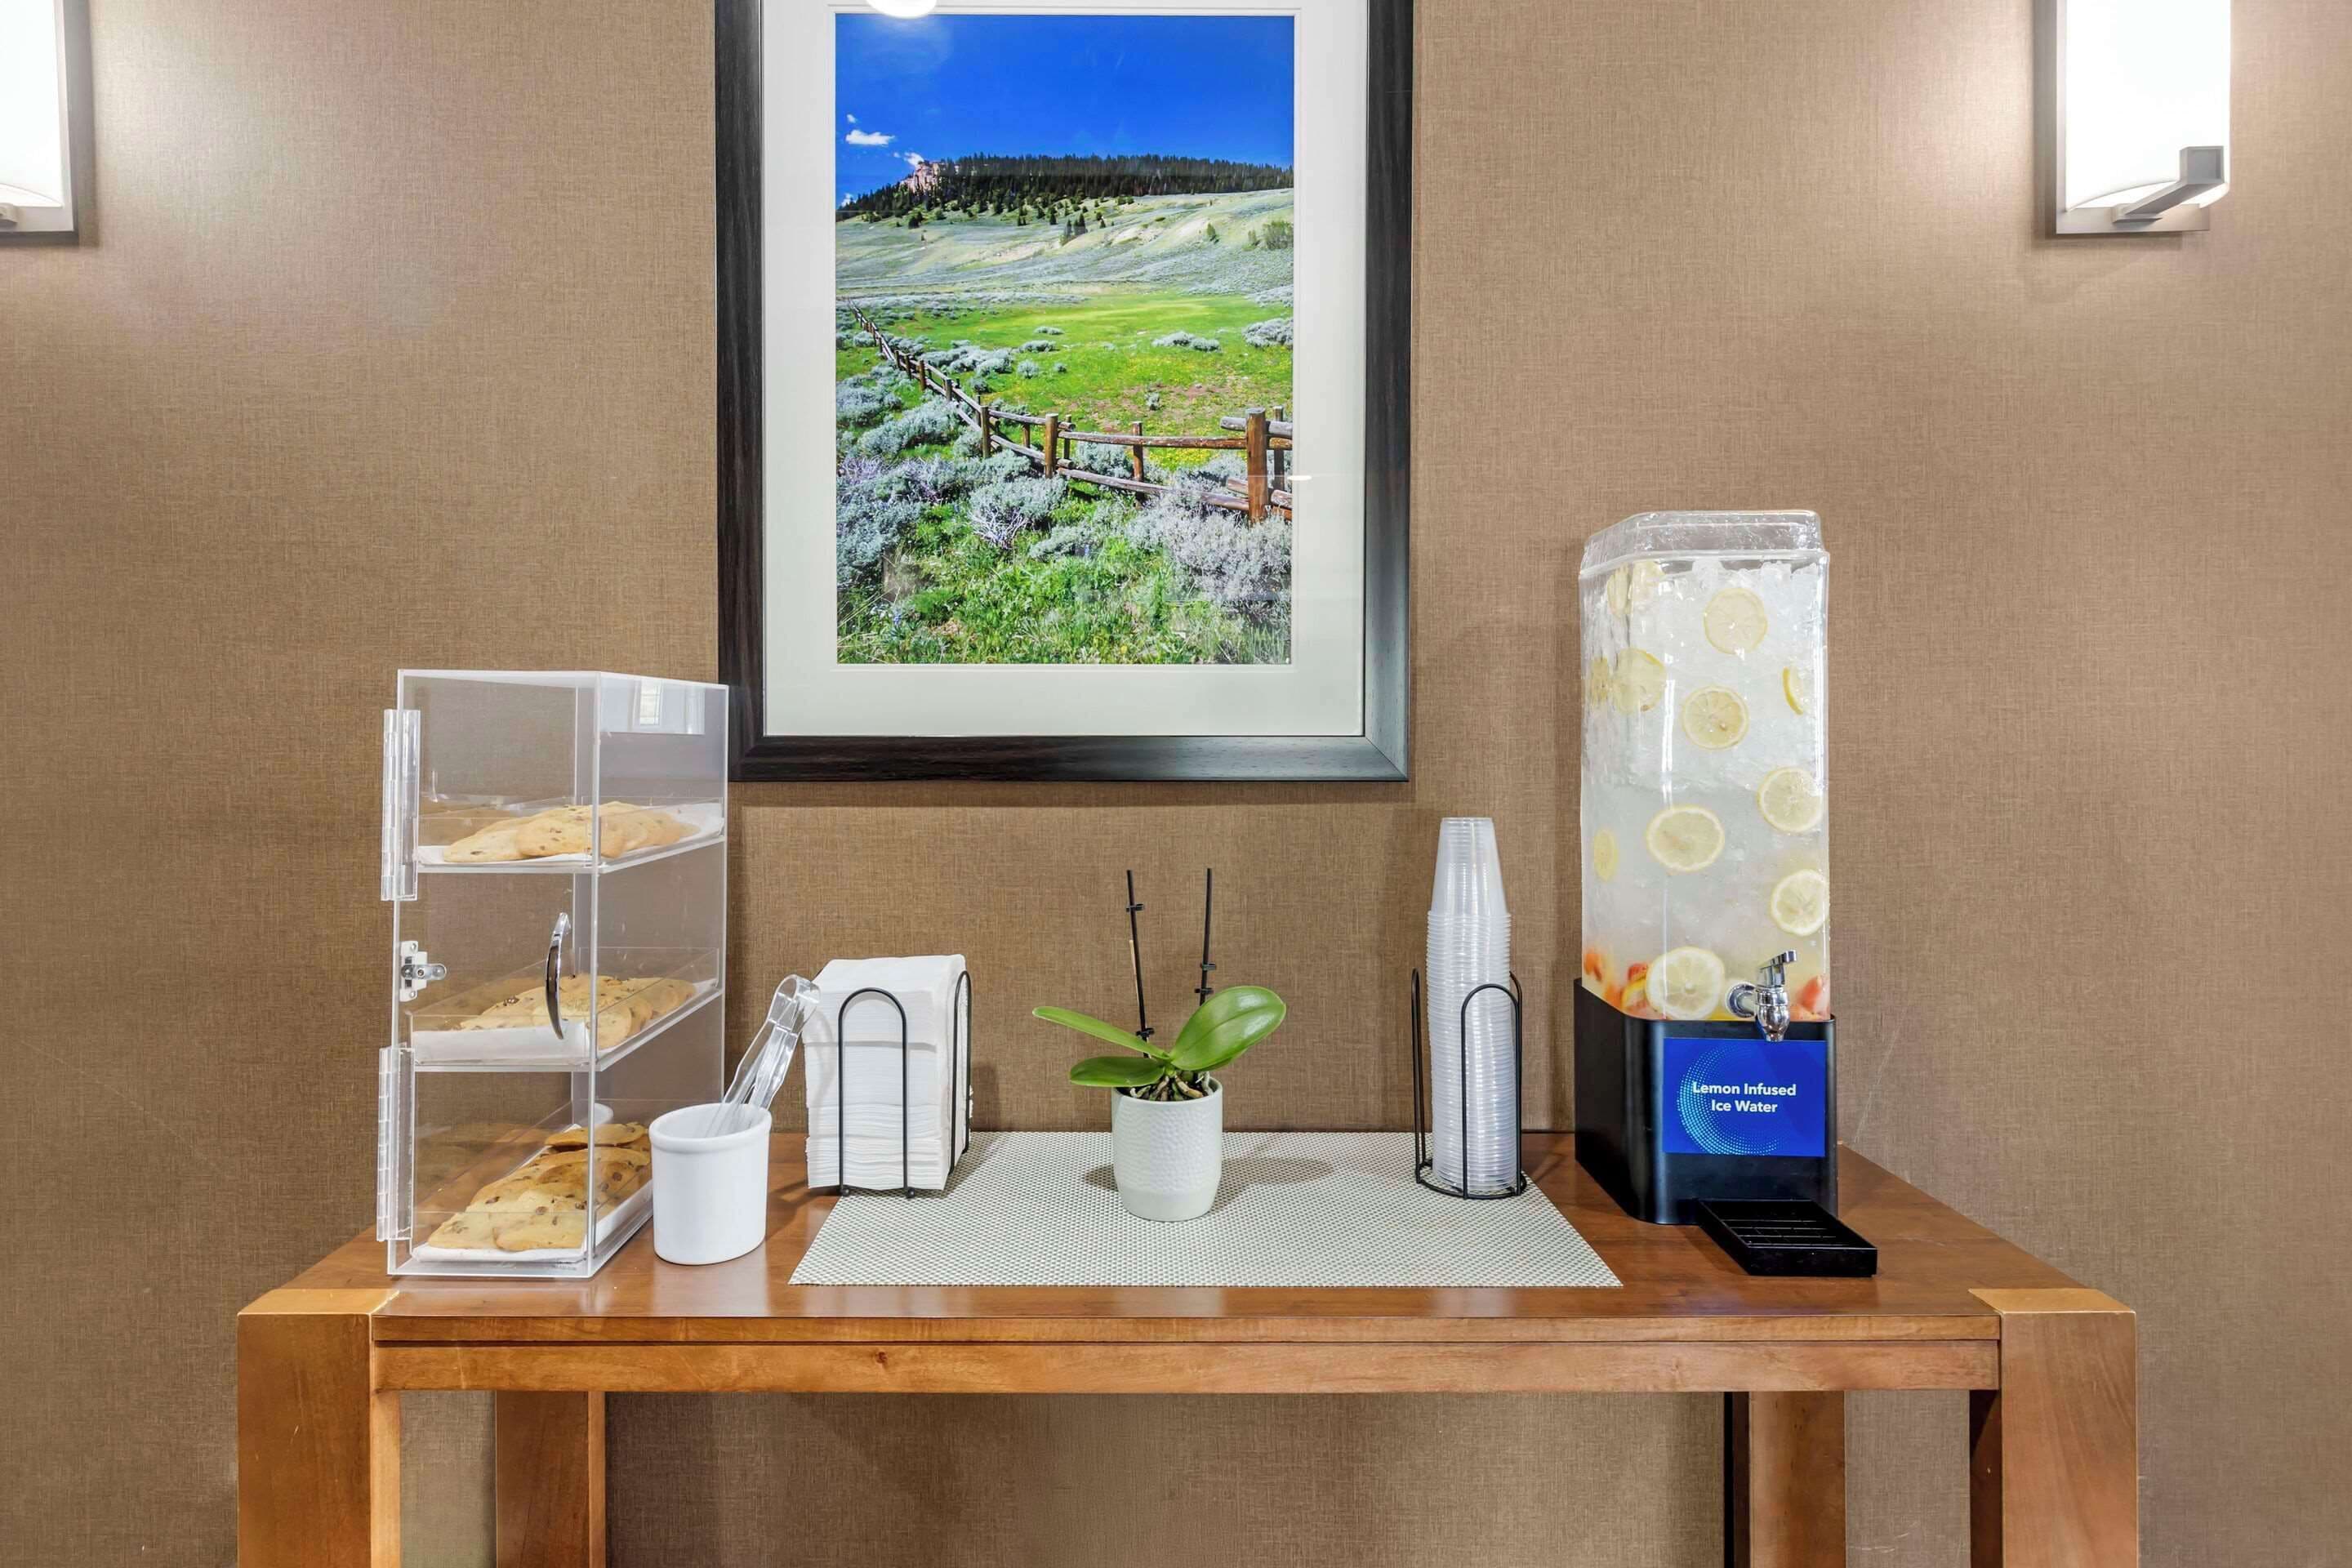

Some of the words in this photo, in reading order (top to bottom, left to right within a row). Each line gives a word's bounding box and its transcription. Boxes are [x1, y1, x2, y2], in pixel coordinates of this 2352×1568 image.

[1692, 1081, 1740, 1094] Lemon
[1744, 1083, 1797, 1096] Infused
[1711, 1099, 1731, 1111] Ice
[1735, 1100, 1778, 1112] Water
